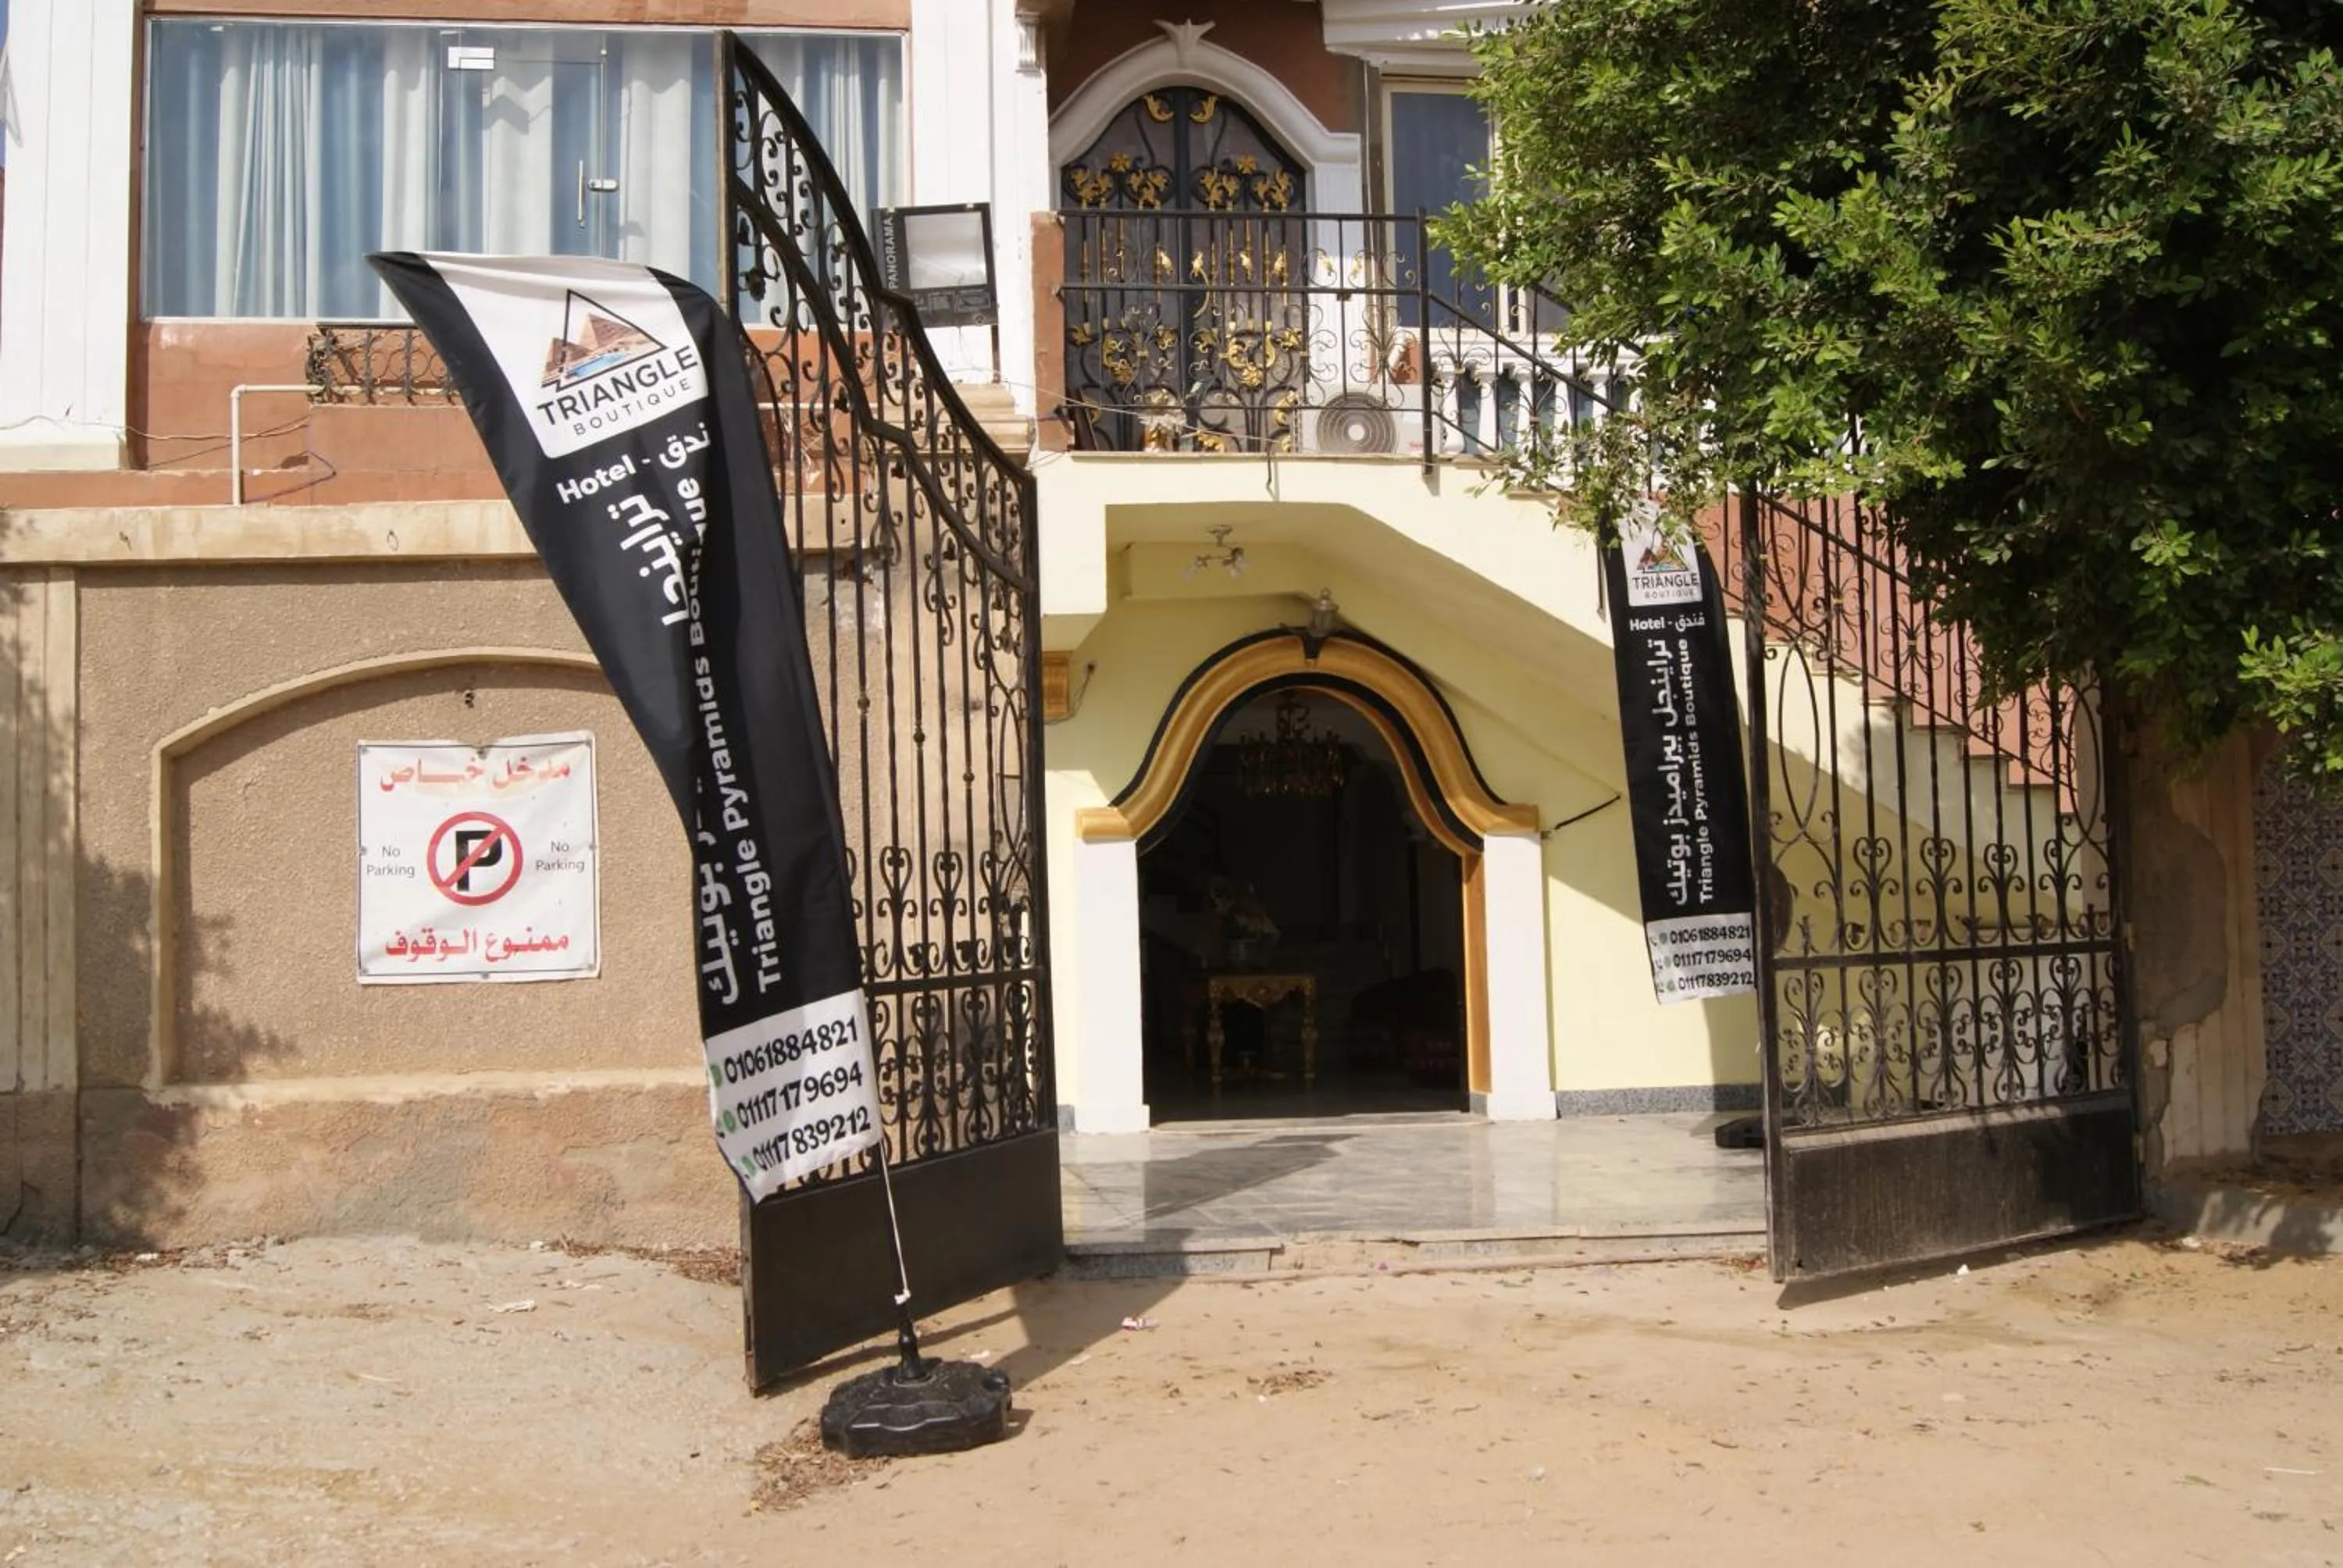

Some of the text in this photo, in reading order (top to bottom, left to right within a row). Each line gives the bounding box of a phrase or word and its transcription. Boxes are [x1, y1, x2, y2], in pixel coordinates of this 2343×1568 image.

[883, 216, 898, 290] PANORAMA
[537, 345, 698, 426] TRIANGLE
[573, 377, 692, 437] BOUTIQUE
[658, 422, 711, 469] ندق
[555, 454, 637, 504] Hotel
[1632, 572, 1699, 590] TRIANGLE
[1644, 588, 1696, 599] BOUTIQUE
[1629, 616, 1665, 631] Hotel
[1675, 611, 1705, 633] فندق
[694, 656, 750, 832] Pyramids
[1647, 639, 1692, 906] تراينجل بيراميدز بوتيك
[1678, 639, 1714, 905] Triangle Pyramids Boutique
[382, 845, 401, 857] No
[535, 858, 585, 874] Parking
[551, 840, 570, 853] No
[366, 864, 415, 878] Parking
[735, 838, 782, 994] Triangle
[1669, 925, 1751, 944] 01061884821
[385, 926, 570, 963] ممنوع الوقوف
[1673, 949, 1752, 968] 01117179694
[1678, 971, 1753, 990] 01117839212
[724, 1015, 858, 1084] 01061884821
[736, 1060, 863, 1129] 01117179694
[752, 1105, 872, 1171] 01117839212
